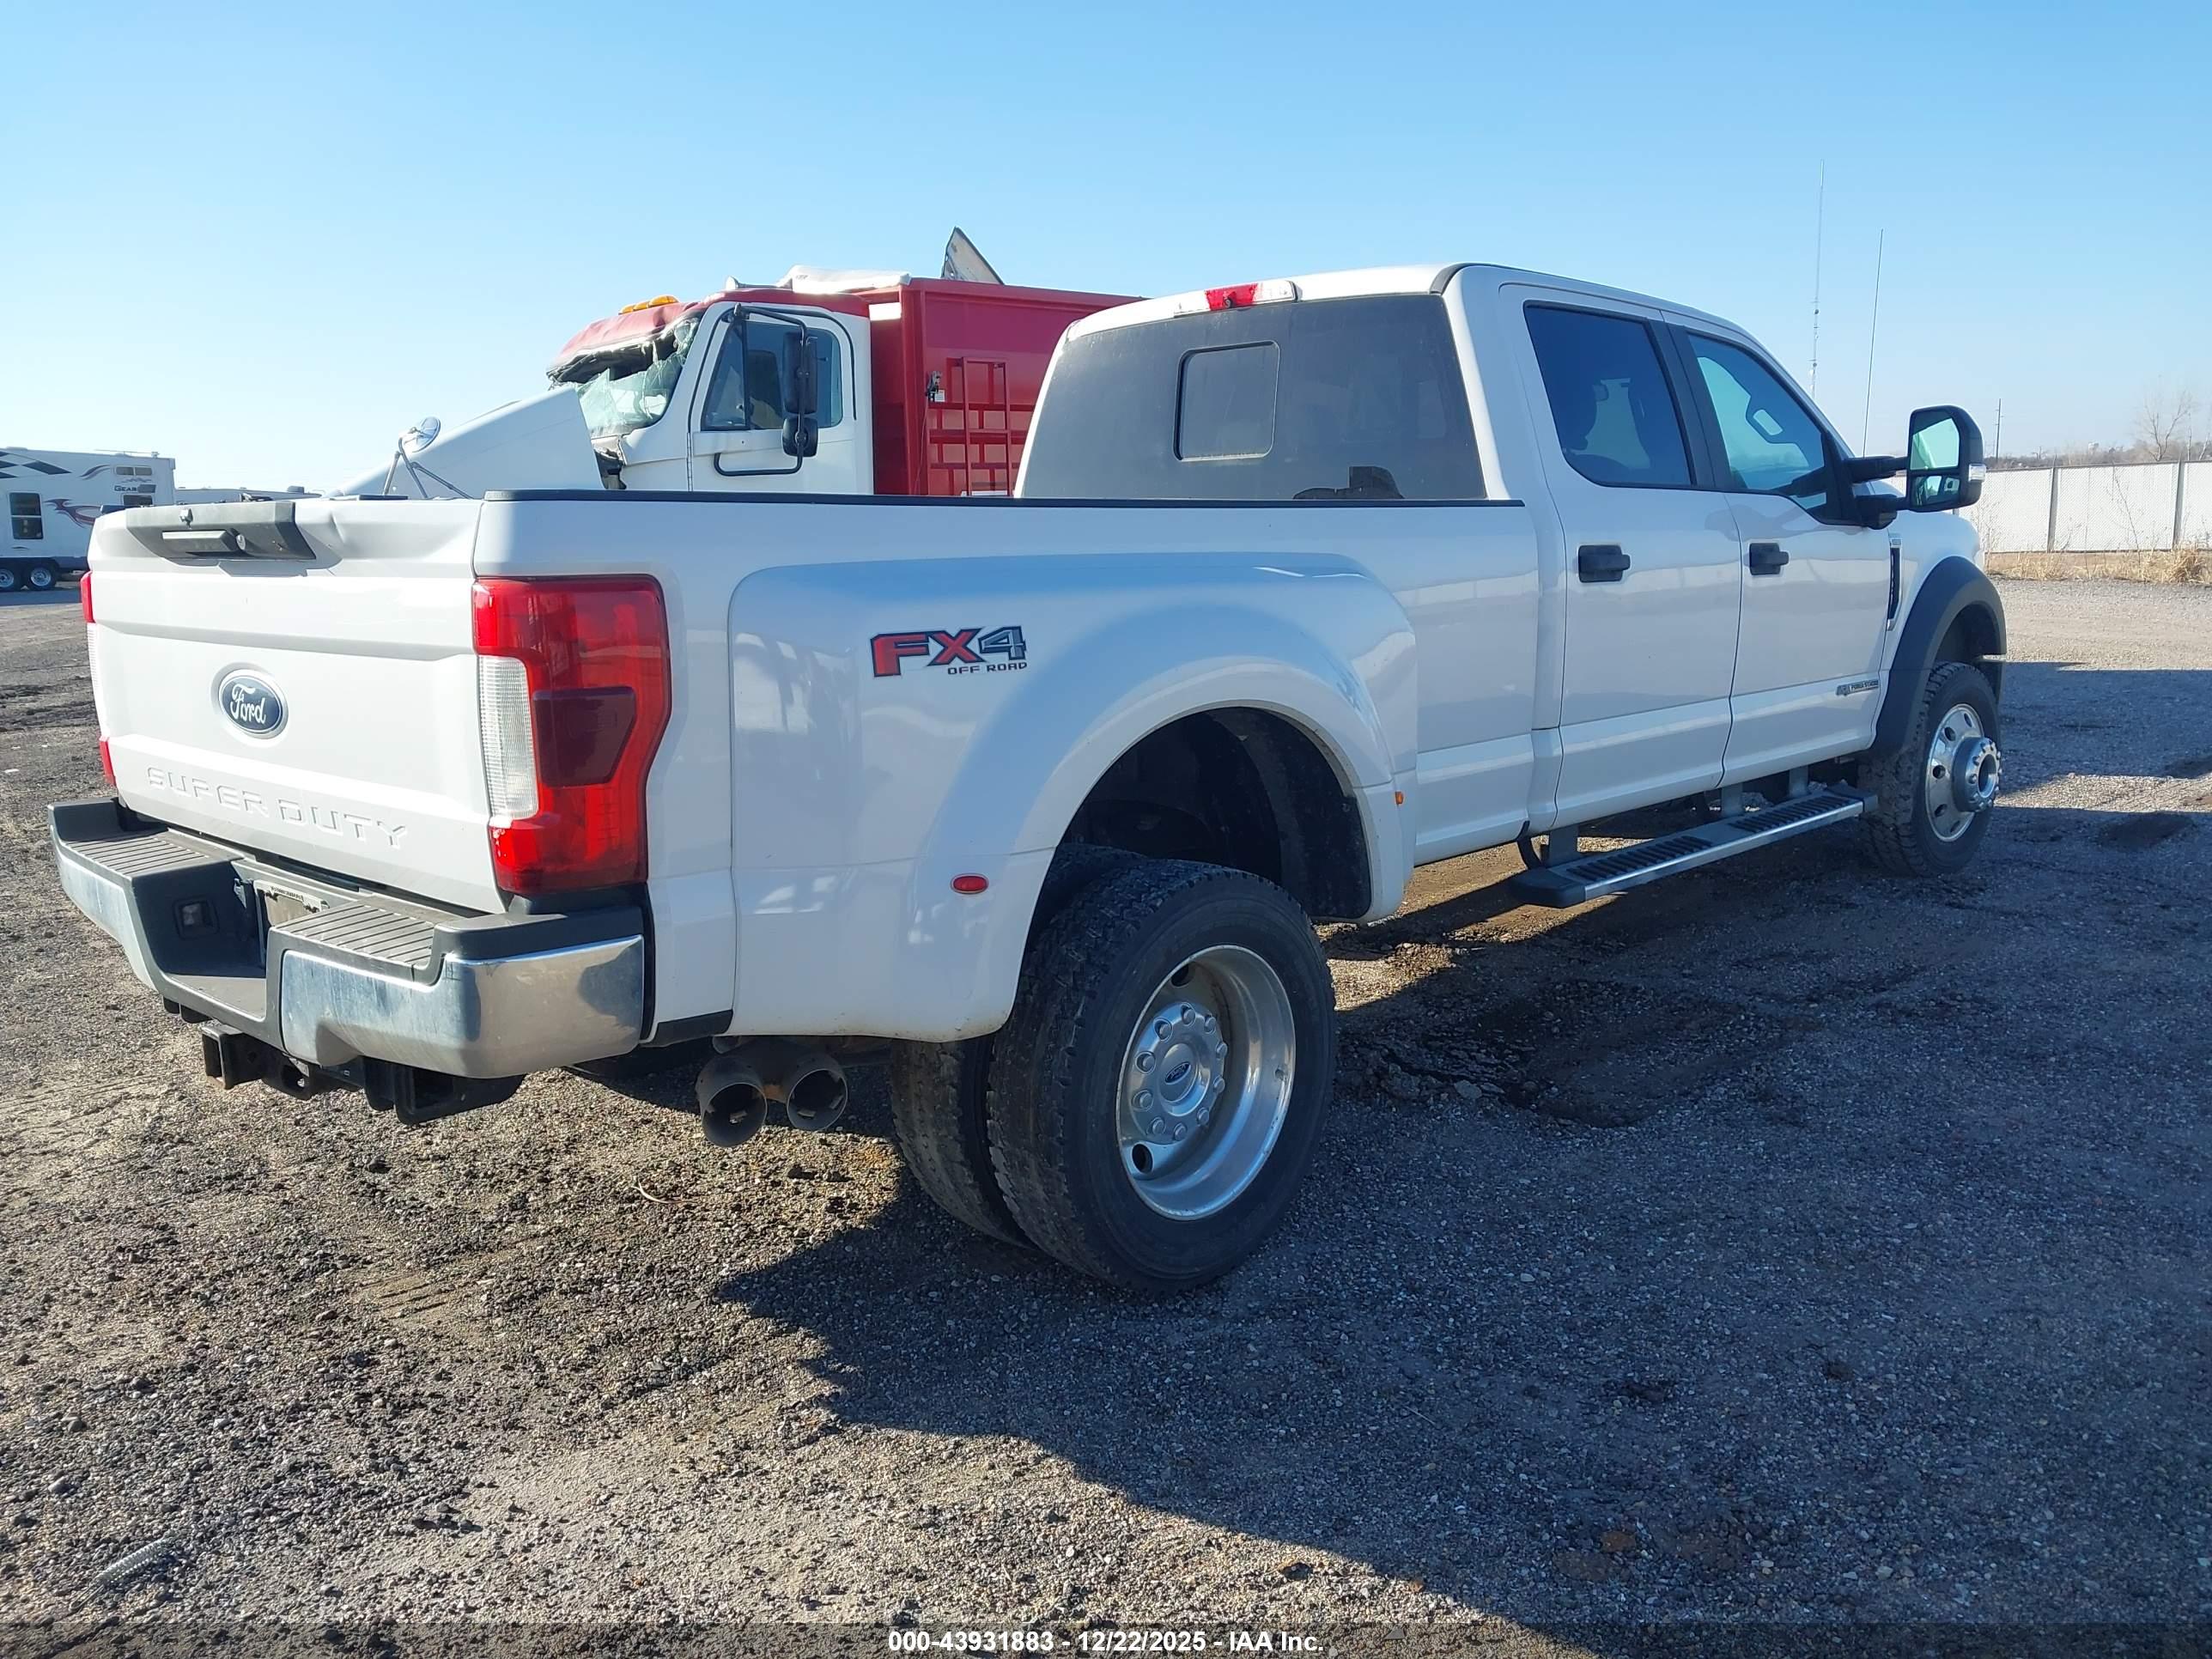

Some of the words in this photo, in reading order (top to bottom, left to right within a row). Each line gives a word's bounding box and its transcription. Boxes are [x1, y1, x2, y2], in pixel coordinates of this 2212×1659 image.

[870, 625, 1027, 678] FX4
[947, 665, 981, 675] OFF
[987, 661, 1028, 672] ROAD
[229, 683, 267, 725] Ford
[147, 767, 270, 817] SUPER
[277, 799, 408, 850] DUTY
